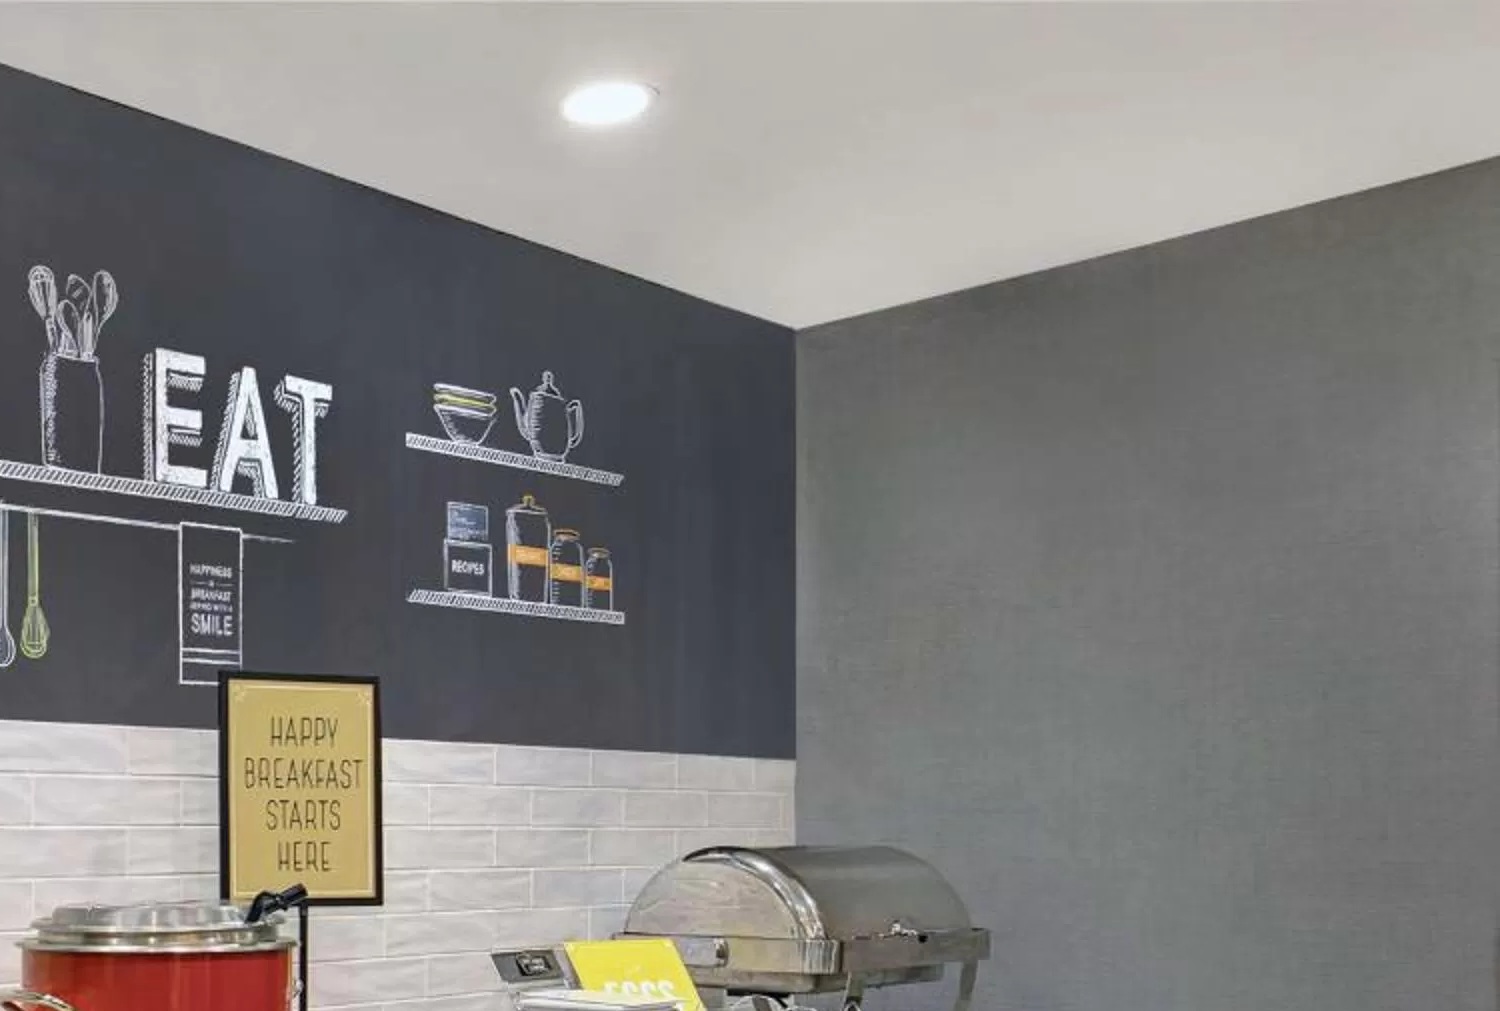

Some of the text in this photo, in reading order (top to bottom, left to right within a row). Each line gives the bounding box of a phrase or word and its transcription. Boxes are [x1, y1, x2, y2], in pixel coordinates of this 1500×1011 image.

[143, 347, 333, 506] EAT
[451, 559, 485, 576] RECIPES
[190, 612, 234, 637] SMILE
[270, 716, 339, 748] HAPPY
[243, 757, 364, 789] BREAKFAST
[265, 799, 341, 831] STARTS
[277, 841, 333, 872] HERE
